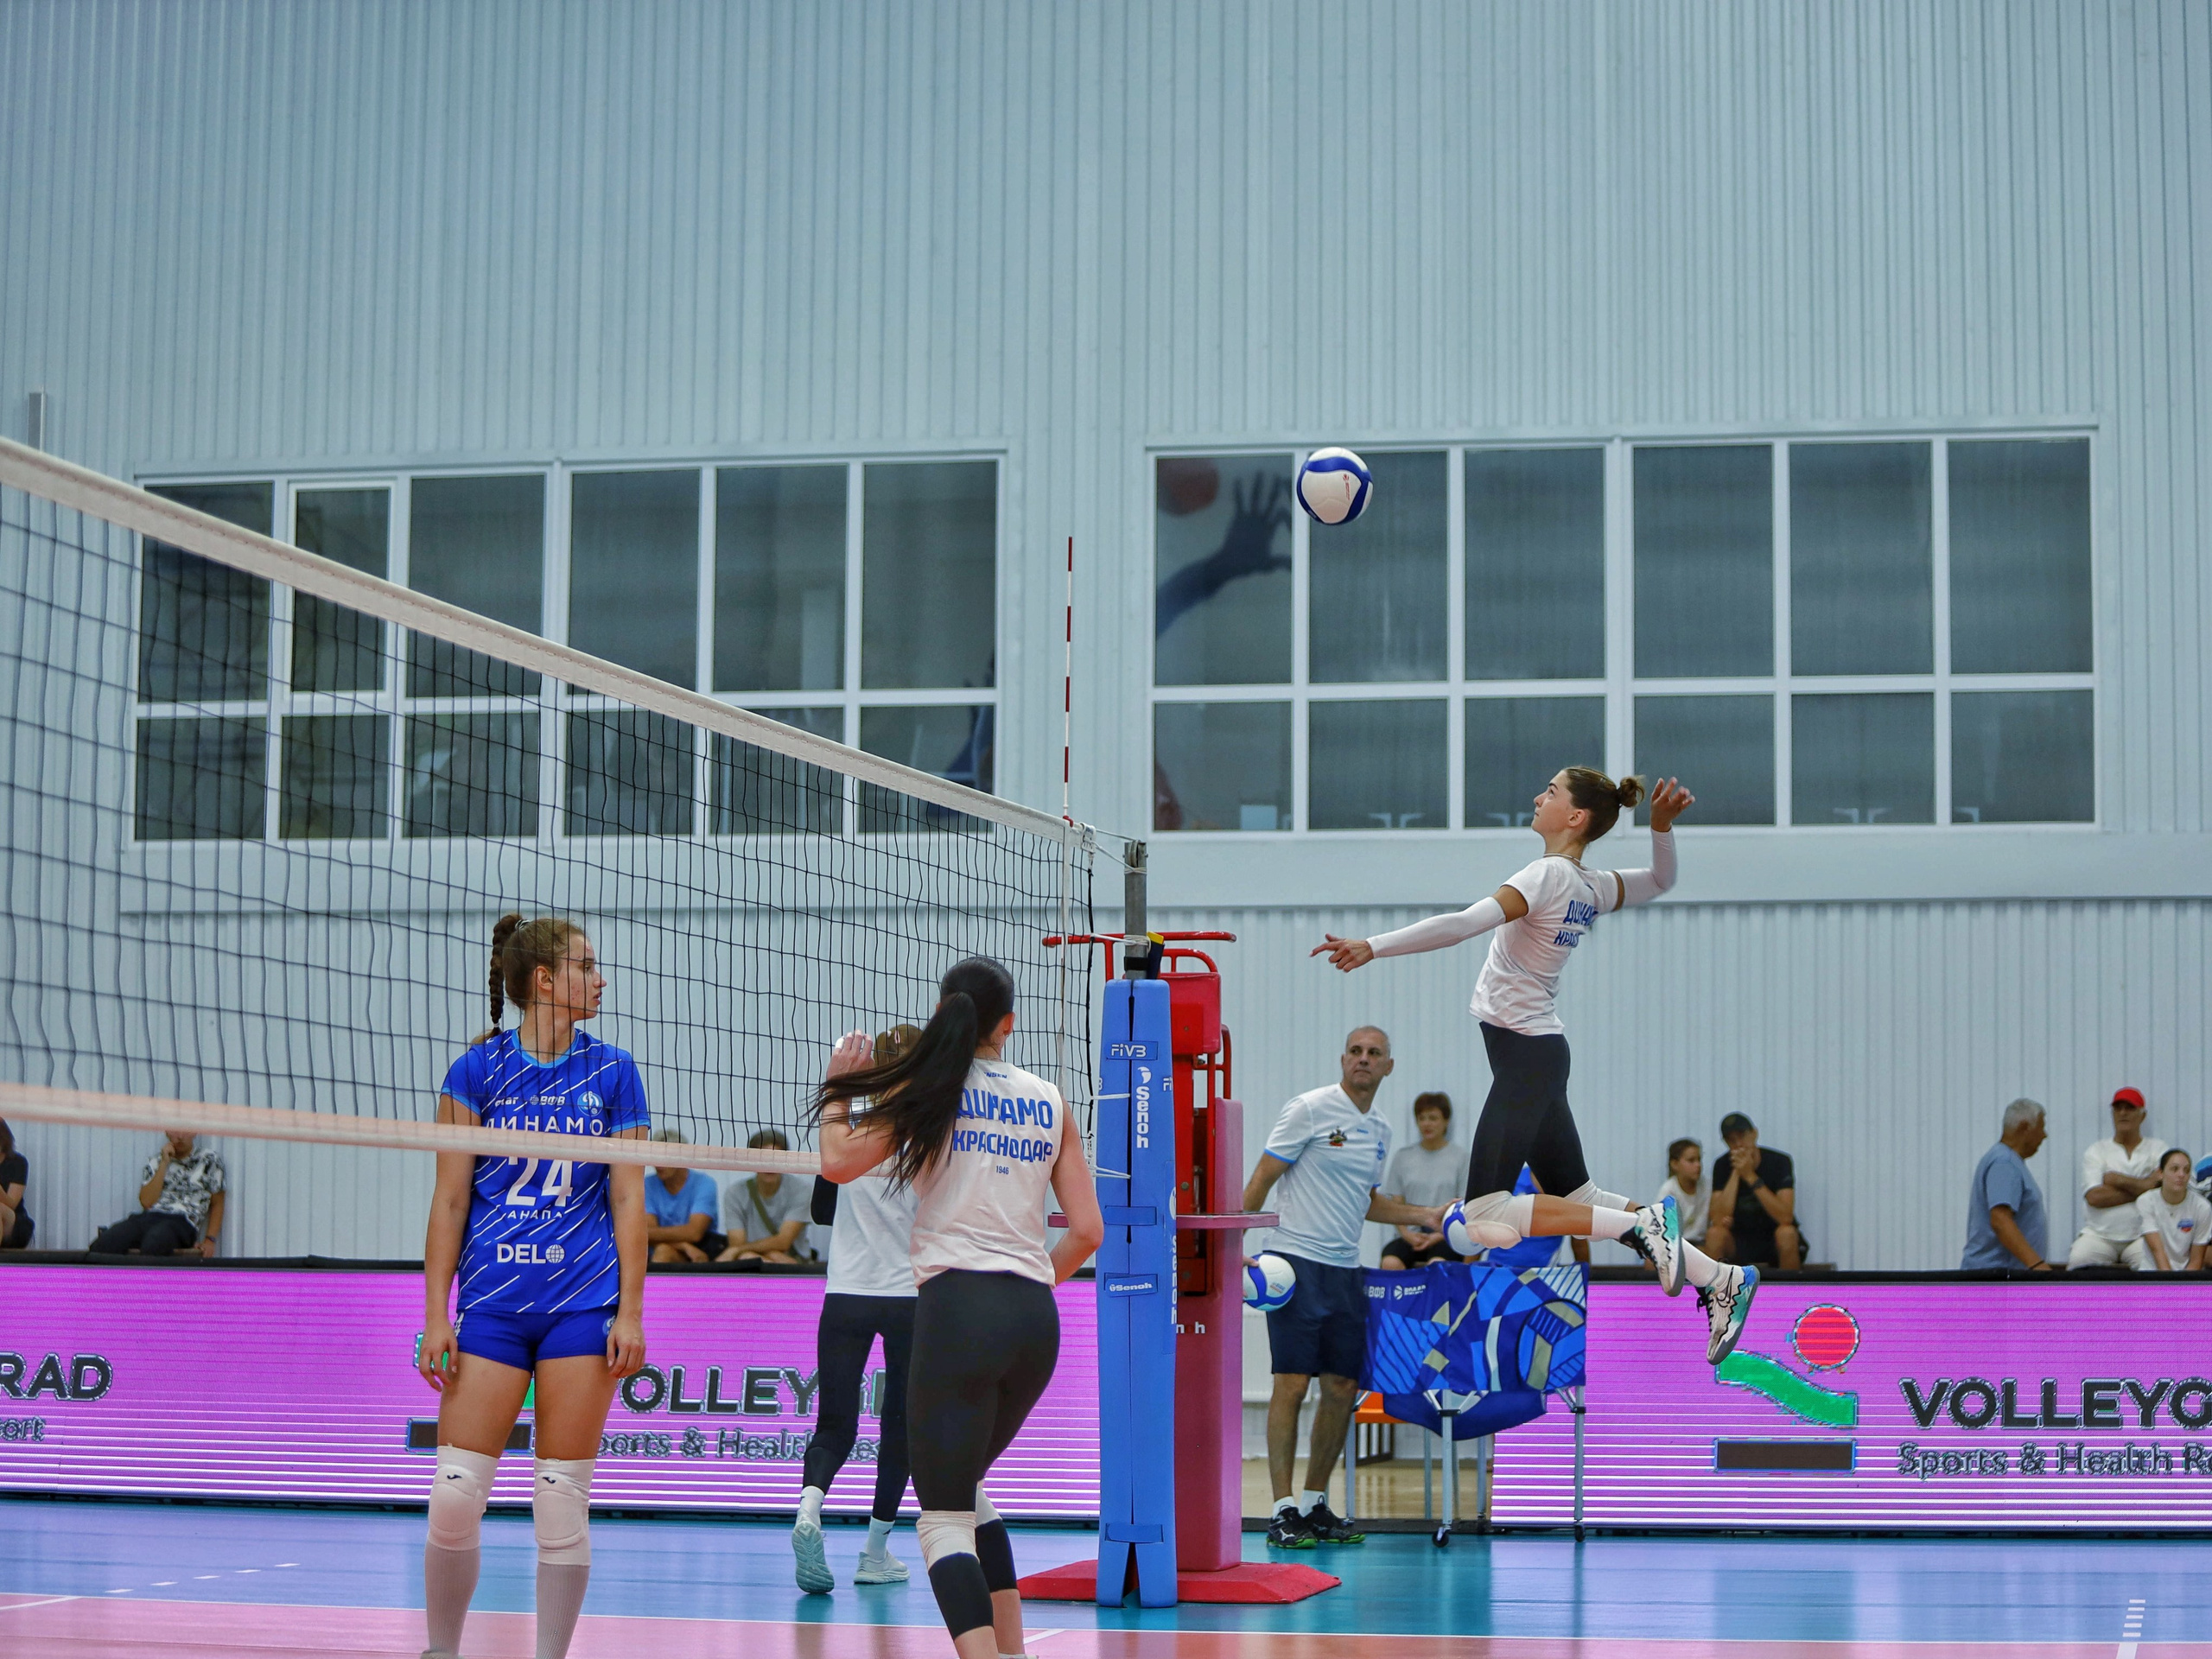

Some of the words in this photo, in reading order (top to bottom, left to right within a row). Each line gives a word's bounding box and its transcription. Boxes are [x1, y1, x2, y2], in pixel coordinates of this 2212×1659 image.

[486, 1115, 604, 1136] ДИНАМО
[953, 1130, 1053, 1163] КРАСНОДАР
[505, 1156, 573, 1207] 24
[507, 1210, 563, 1220] АНАПА
[0, 1351, 113, 1402] RAD
[0, 1415, 47, 1442] ort
[680, 1426, 706, 1459] &
[1897, 1440, 2009, 1482] Sports
[2017, 1441, 2047, 1476] &
[2056, 1441, 2174, 1476] Health
